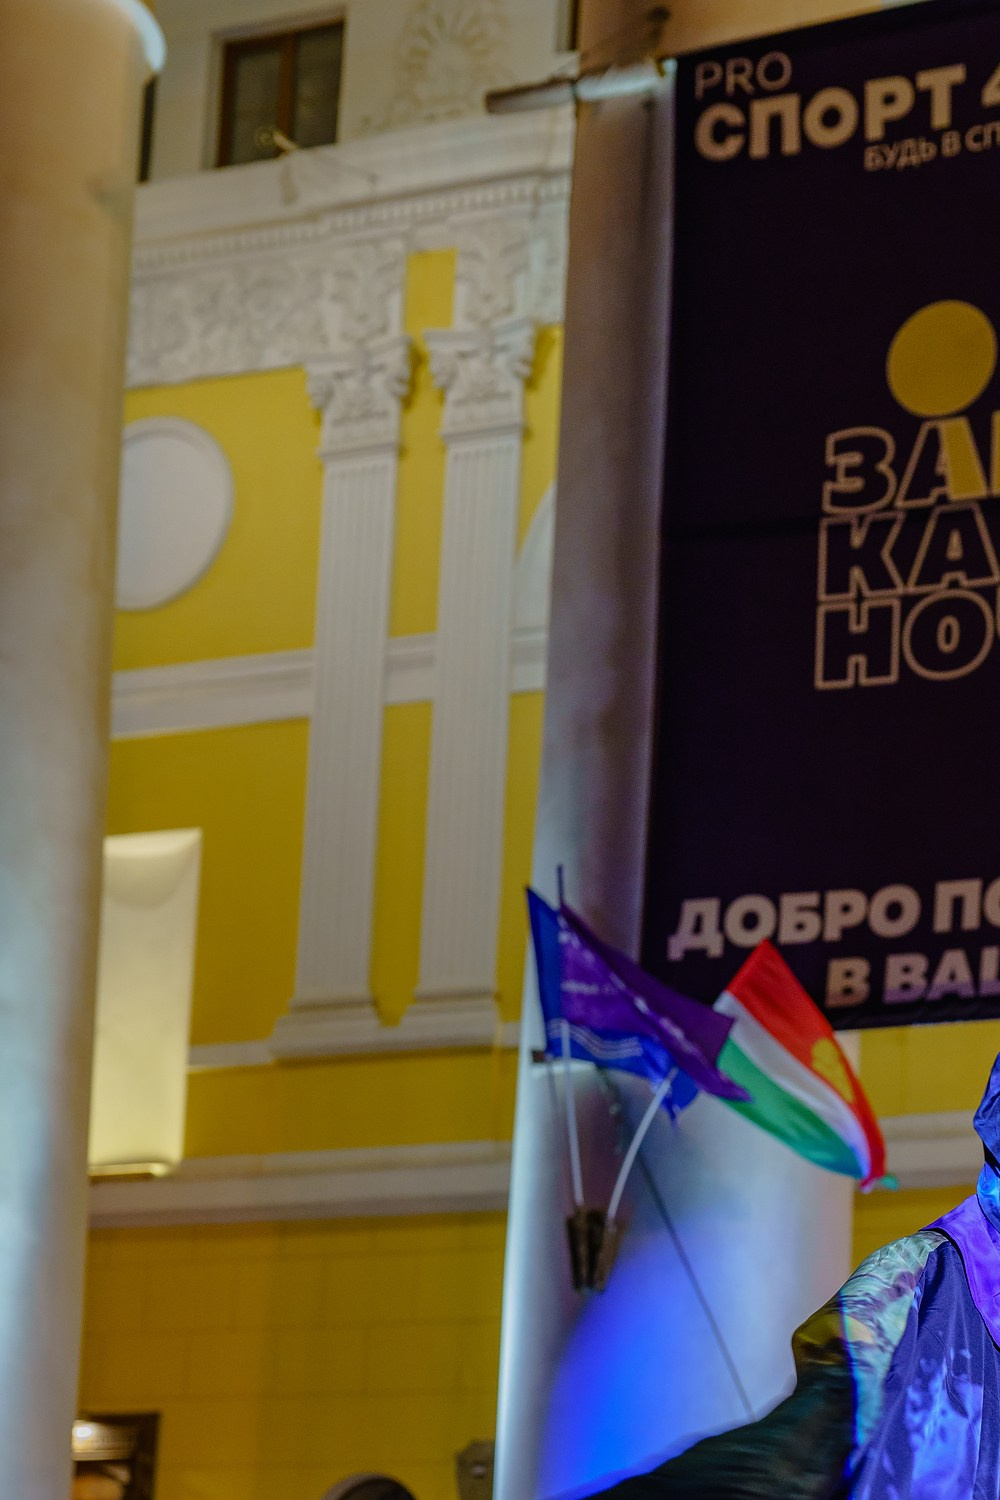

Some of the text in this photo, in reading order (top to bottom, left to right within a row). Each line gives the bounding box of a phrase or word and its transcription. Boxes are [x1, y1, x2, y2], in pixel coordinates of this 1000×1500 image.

[694, 50, 793, 97] PRO
[694, 63, 967, 162] СПОРТ
[863, 136, 938, 171] БУДЬ
[940, 129, 962, 158] В
[667, 884, 922, 962] ДОБРО
[824, 955, 871, 1009] В
